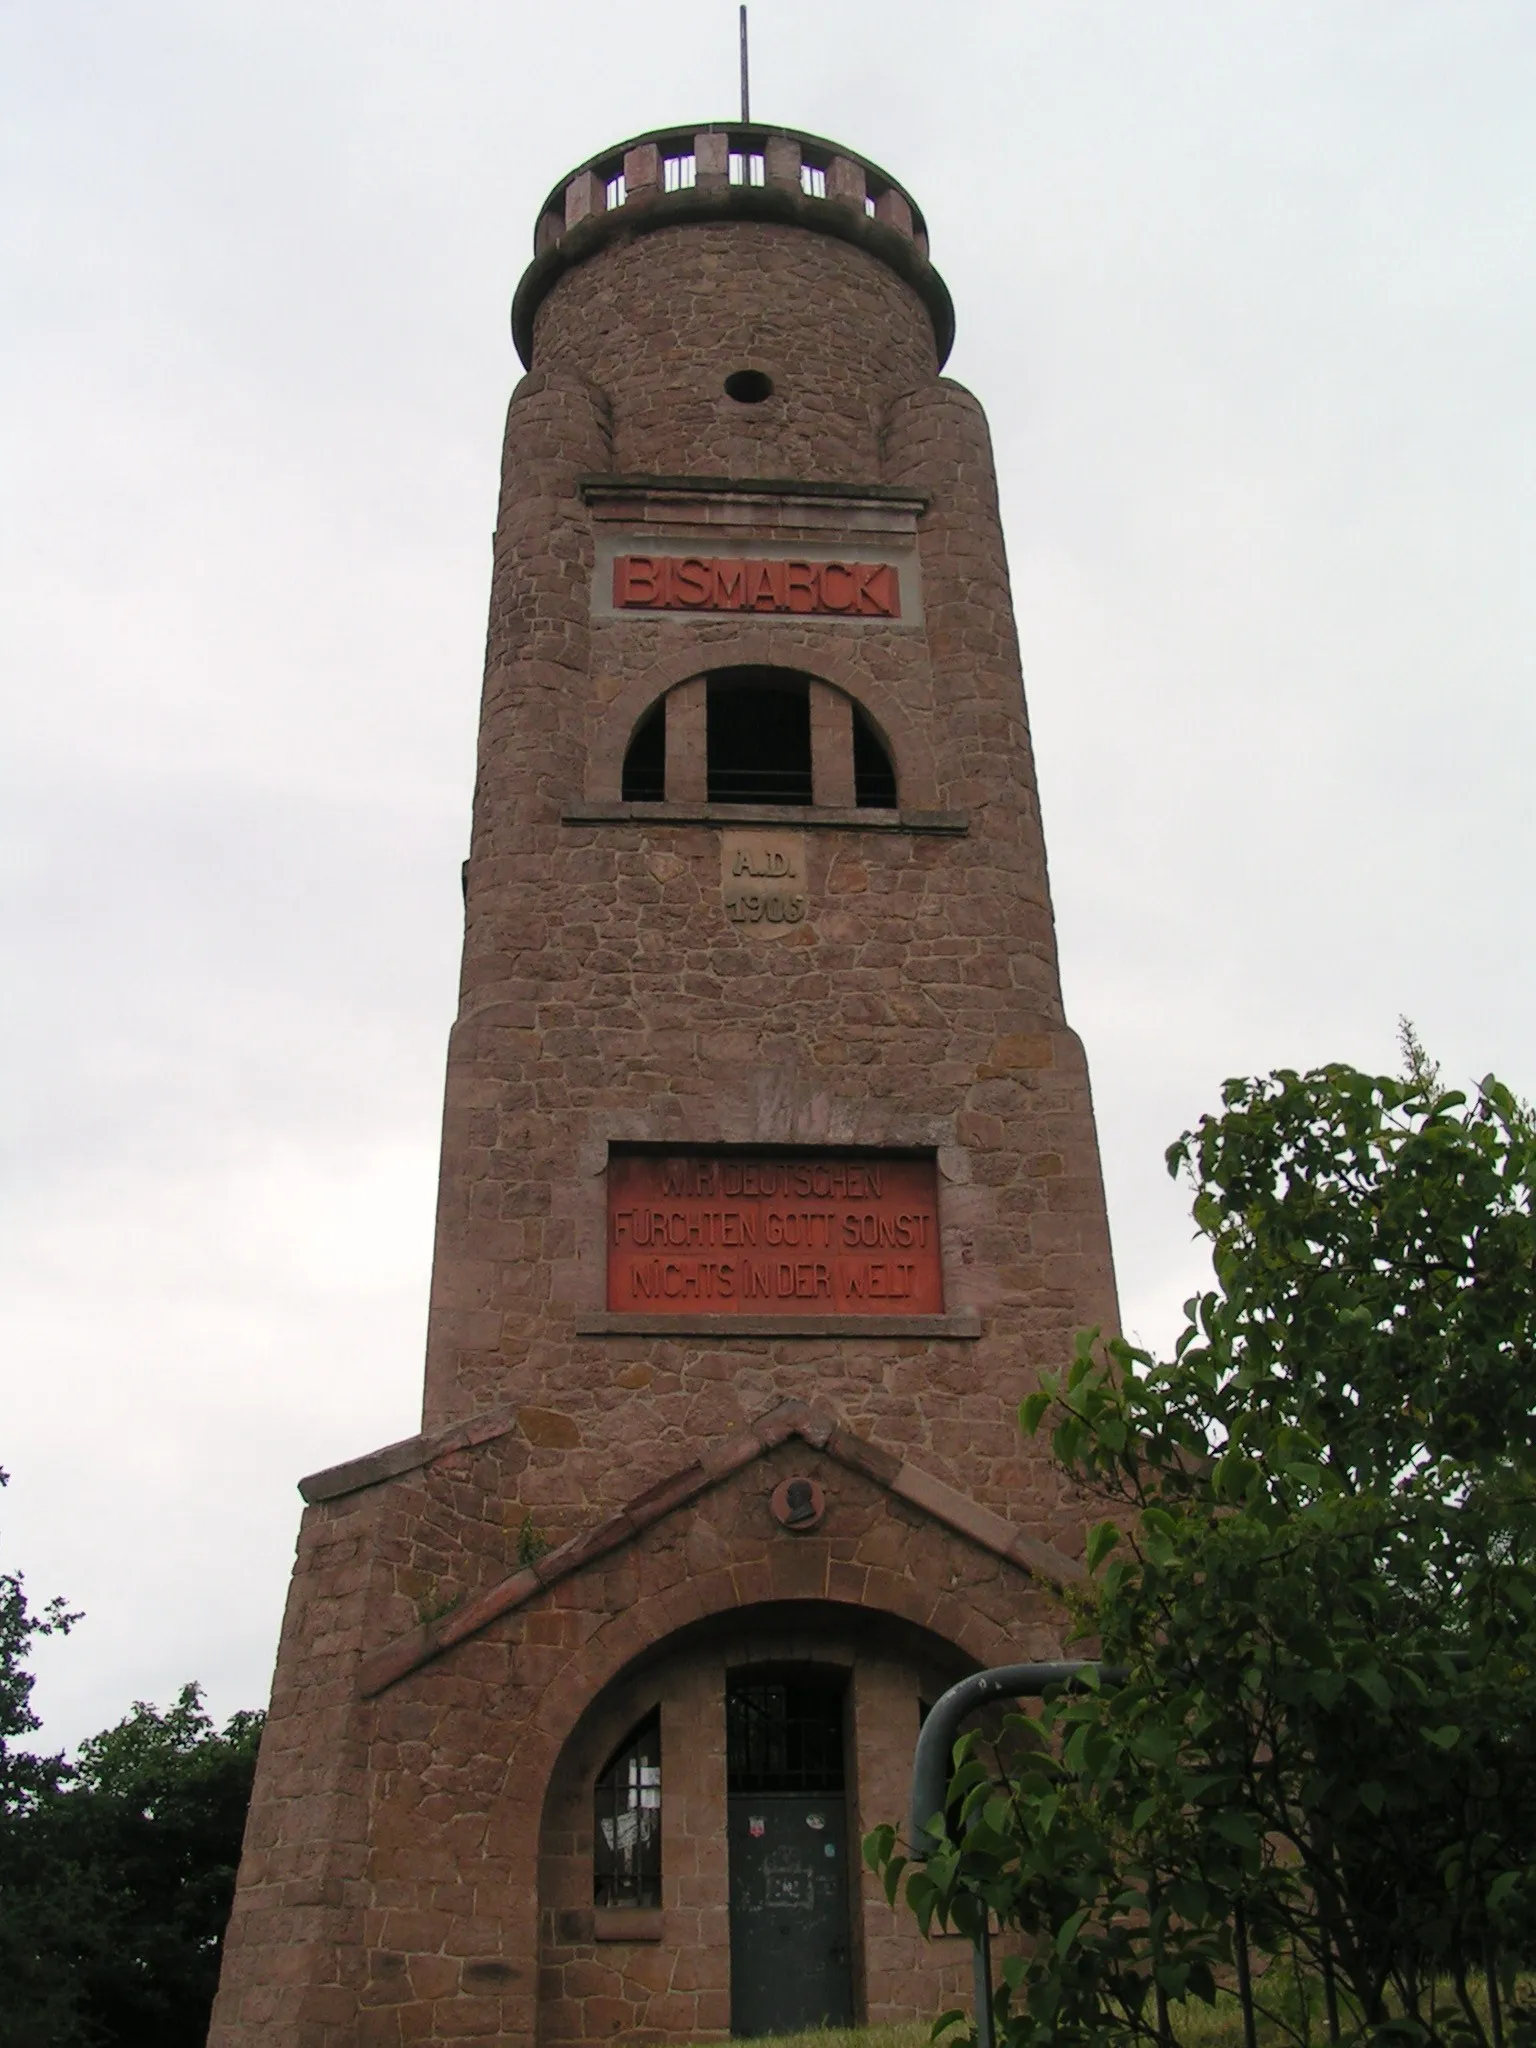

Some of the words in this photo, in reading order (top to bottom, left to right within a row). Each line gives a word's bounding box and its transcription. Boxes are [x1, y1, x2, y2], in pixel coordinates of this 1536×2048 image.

[624, 555, 892, 615] BISMARCK
[732, 850, 797, 878] A.D.
[659, 1163, 714, 1197] WIR
[724, 1164, 883, 1199] DEUTSCHEN
[614, 1208, 756, 1247] FÜRCHTEN
[766, 1212, 836, 1248] GOTT
[842, 1213, 930, 1249] SONST
[631, 1258, 736, 1298] NICHTS
[743, 1258, 770, 1299] IN
[777, 1262, 832, 1299] DER
[838, 1263, 915, 1299] WELT
